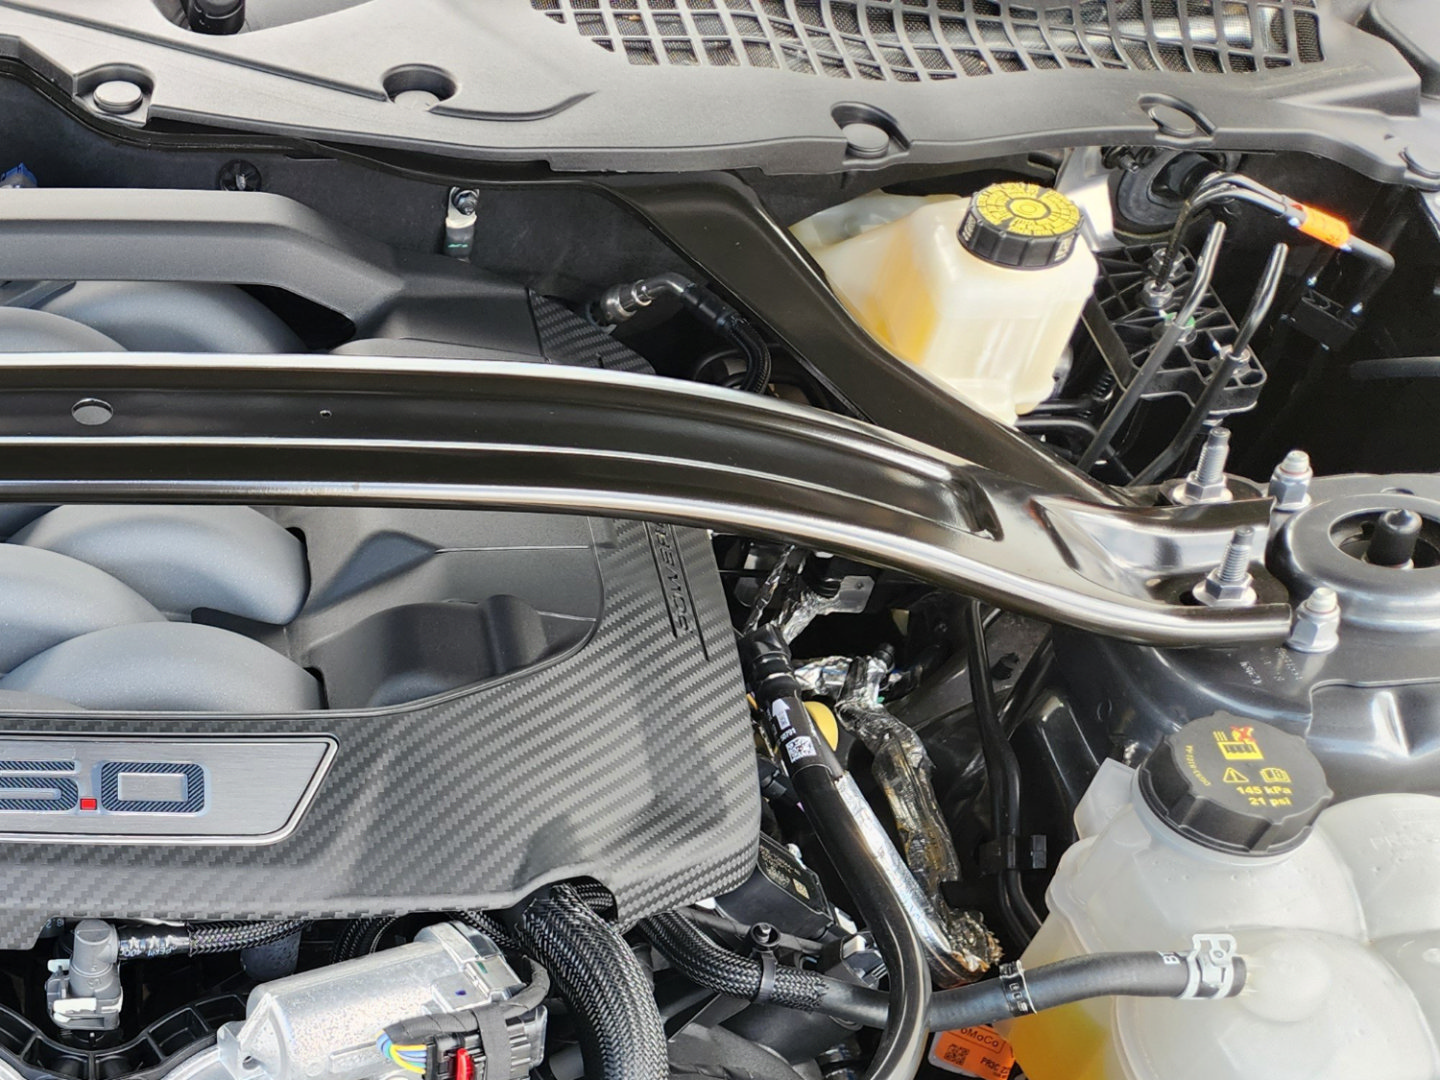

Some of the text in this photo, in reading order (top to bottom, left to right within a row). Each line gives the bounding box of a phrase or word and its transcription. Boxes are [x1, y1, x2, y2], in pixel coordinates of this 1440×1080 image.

[655, 521, 694, 634] POWER
[1236, 785, 1293, 796] 145 kPa
[1248, 797, 1293, 808] 21 psi
[960, 1027, 1000, 1048] oMoCo
